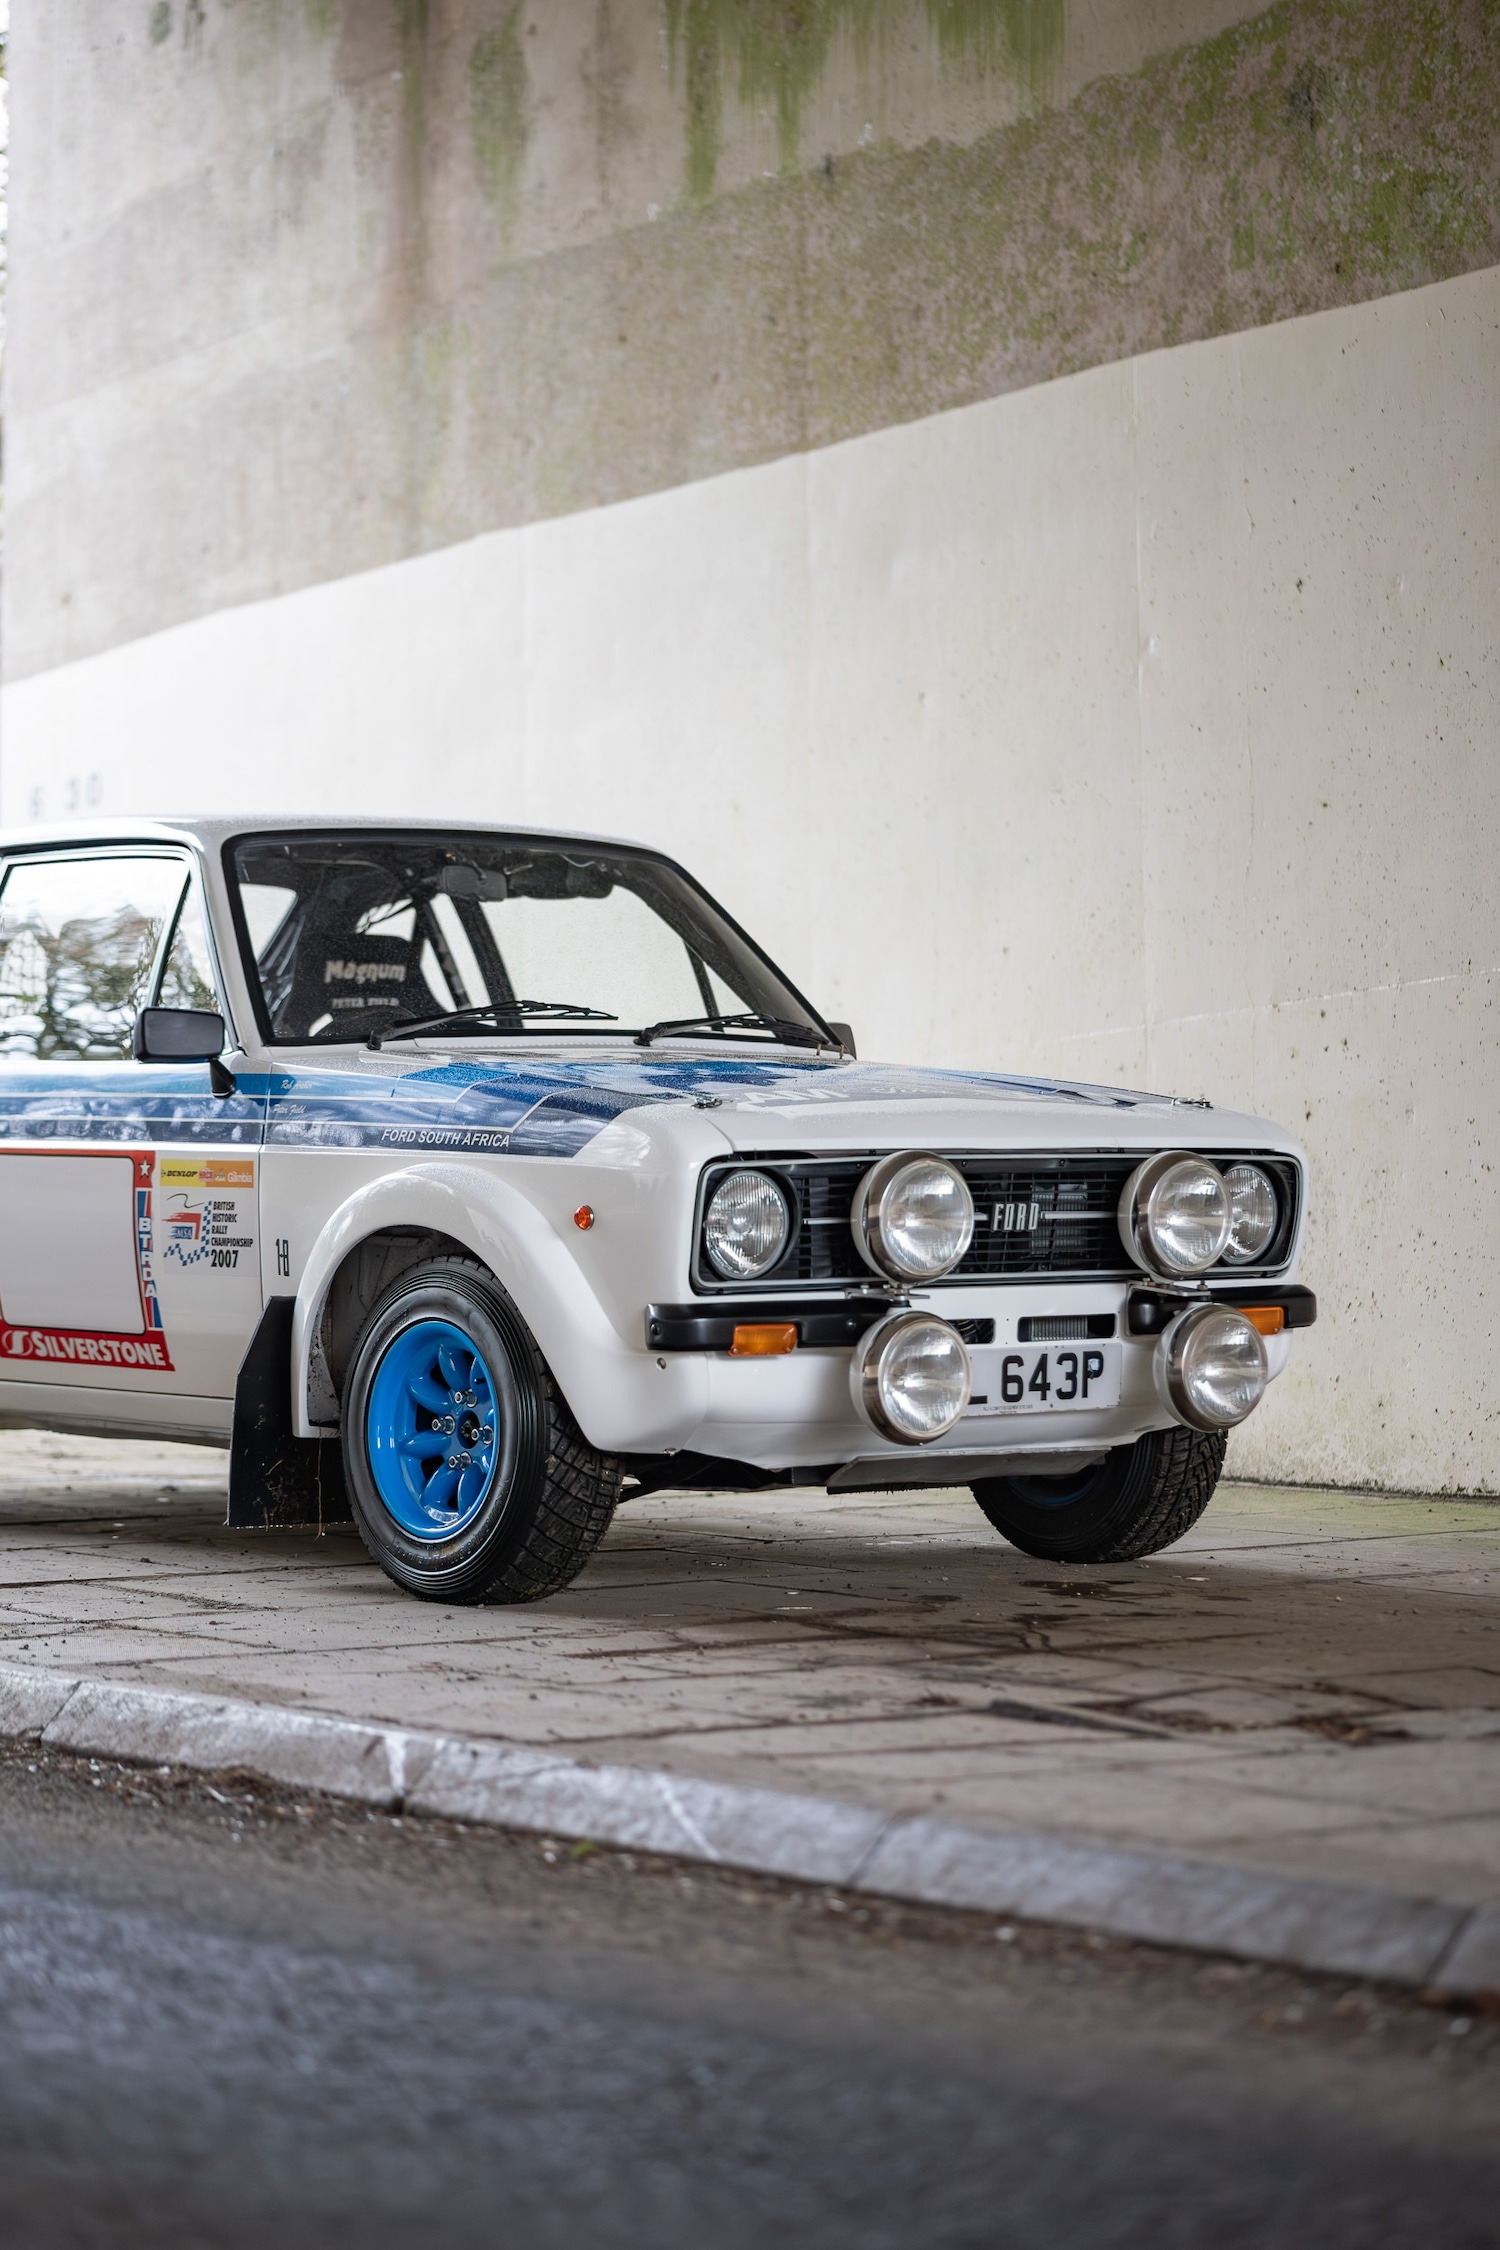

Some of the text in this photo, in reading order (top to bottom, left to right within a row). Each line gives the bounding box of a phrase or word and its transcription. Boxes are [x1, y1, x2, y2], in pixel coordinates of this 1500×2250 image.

[324, 960, 406, 984] Magnum
[381, 1129, 510, 1148] FORD SOUTH AFRICA
[166, 1170, 198, 1178] DUNLOP
[213, 1201, 235, 1211] BRITISH
[212, 1213, 238, 1223] HISTORIC
[993, 1202, 1040, 1231] FORD
[211, 1225, 228, 1235] RALLY
[210, 1237, 254, 1248] CHAMPIONSHIP
[210, 1249, 239, 1268] 2007
[31, 1330, 167, 1366] SILVERSTONE
[1001, 1350, 1104, 1403] 643P
